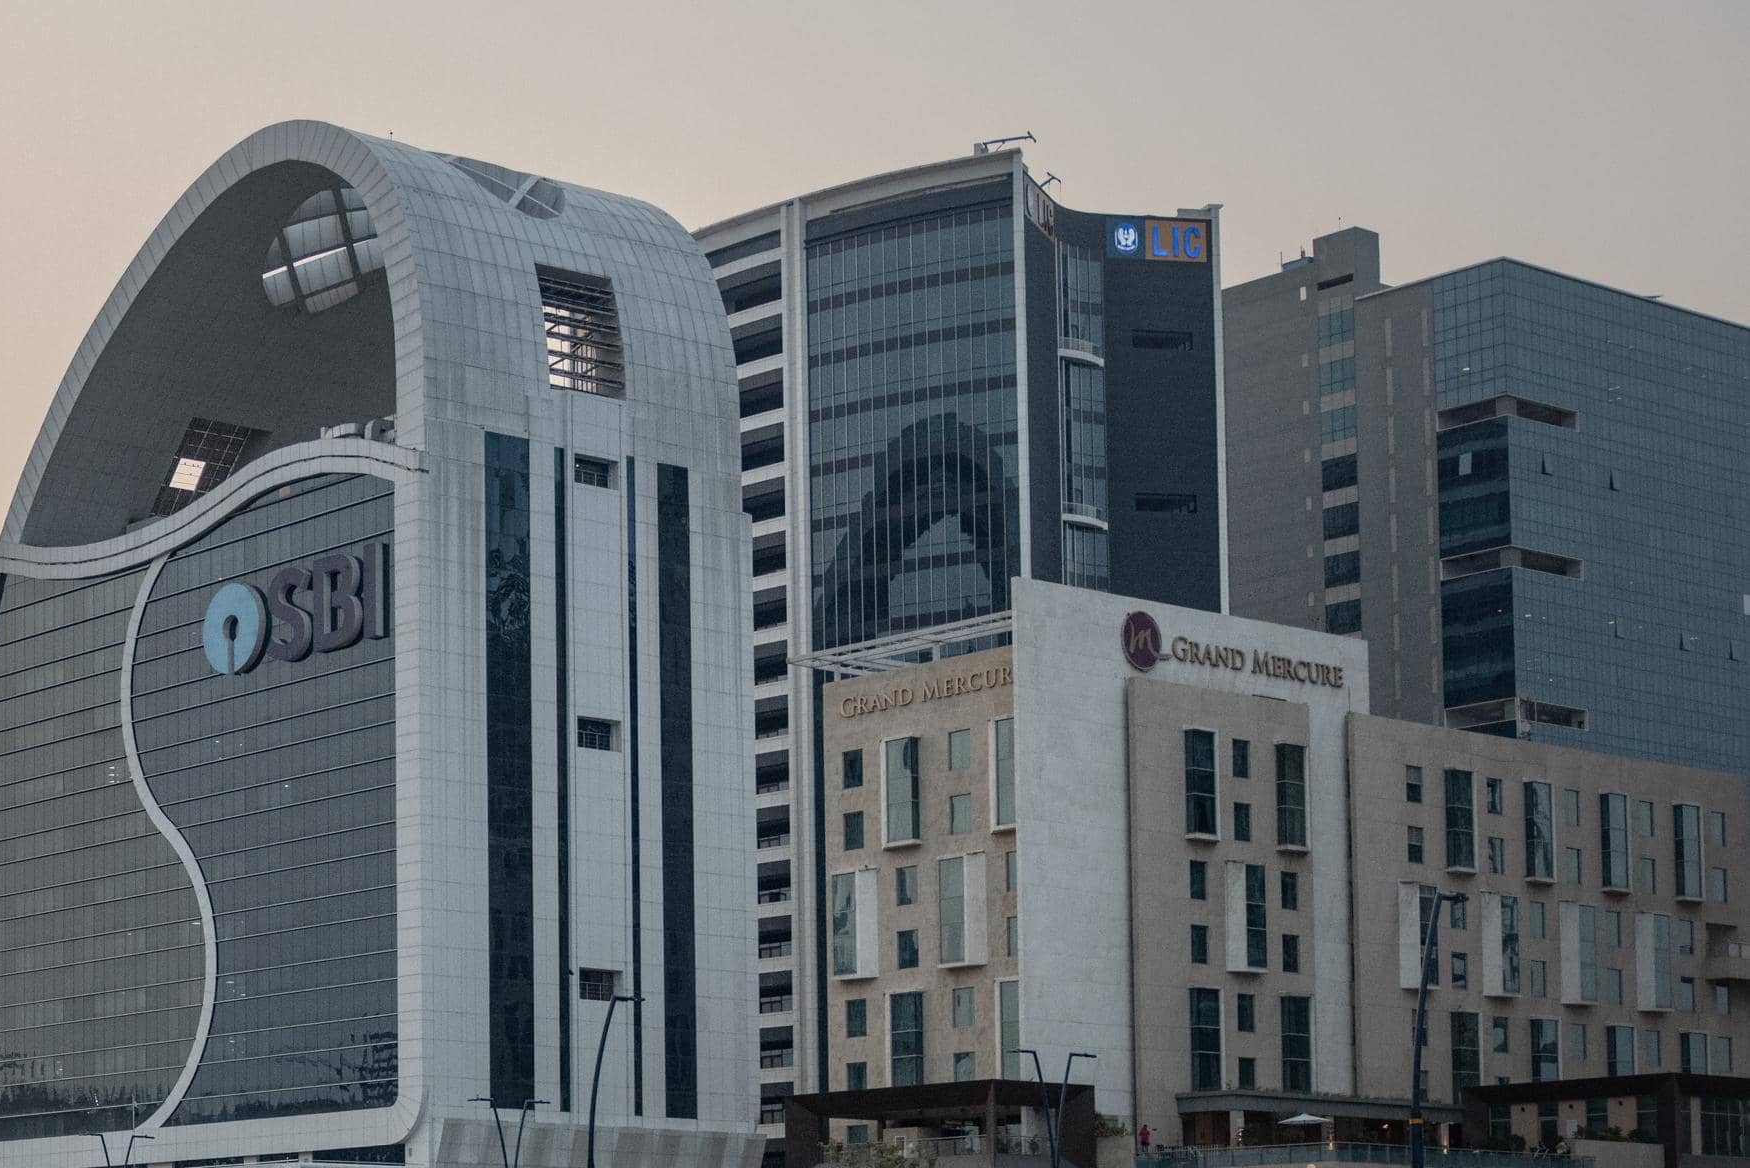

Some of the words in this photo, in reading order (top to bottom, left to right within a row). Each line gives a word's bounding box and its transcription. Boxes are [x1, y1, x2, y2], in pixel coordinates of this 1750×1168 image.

[1152, 224, 1202, 259] LIC
[266, 542, 391, 662] SBI
[1171, 636, 1246, 671] GRAND
[1250, 649, 1345, 688] MERCURE
[840, 688, 914, 718] GRAND
[921, 666, 1013, 703] MERCUR
